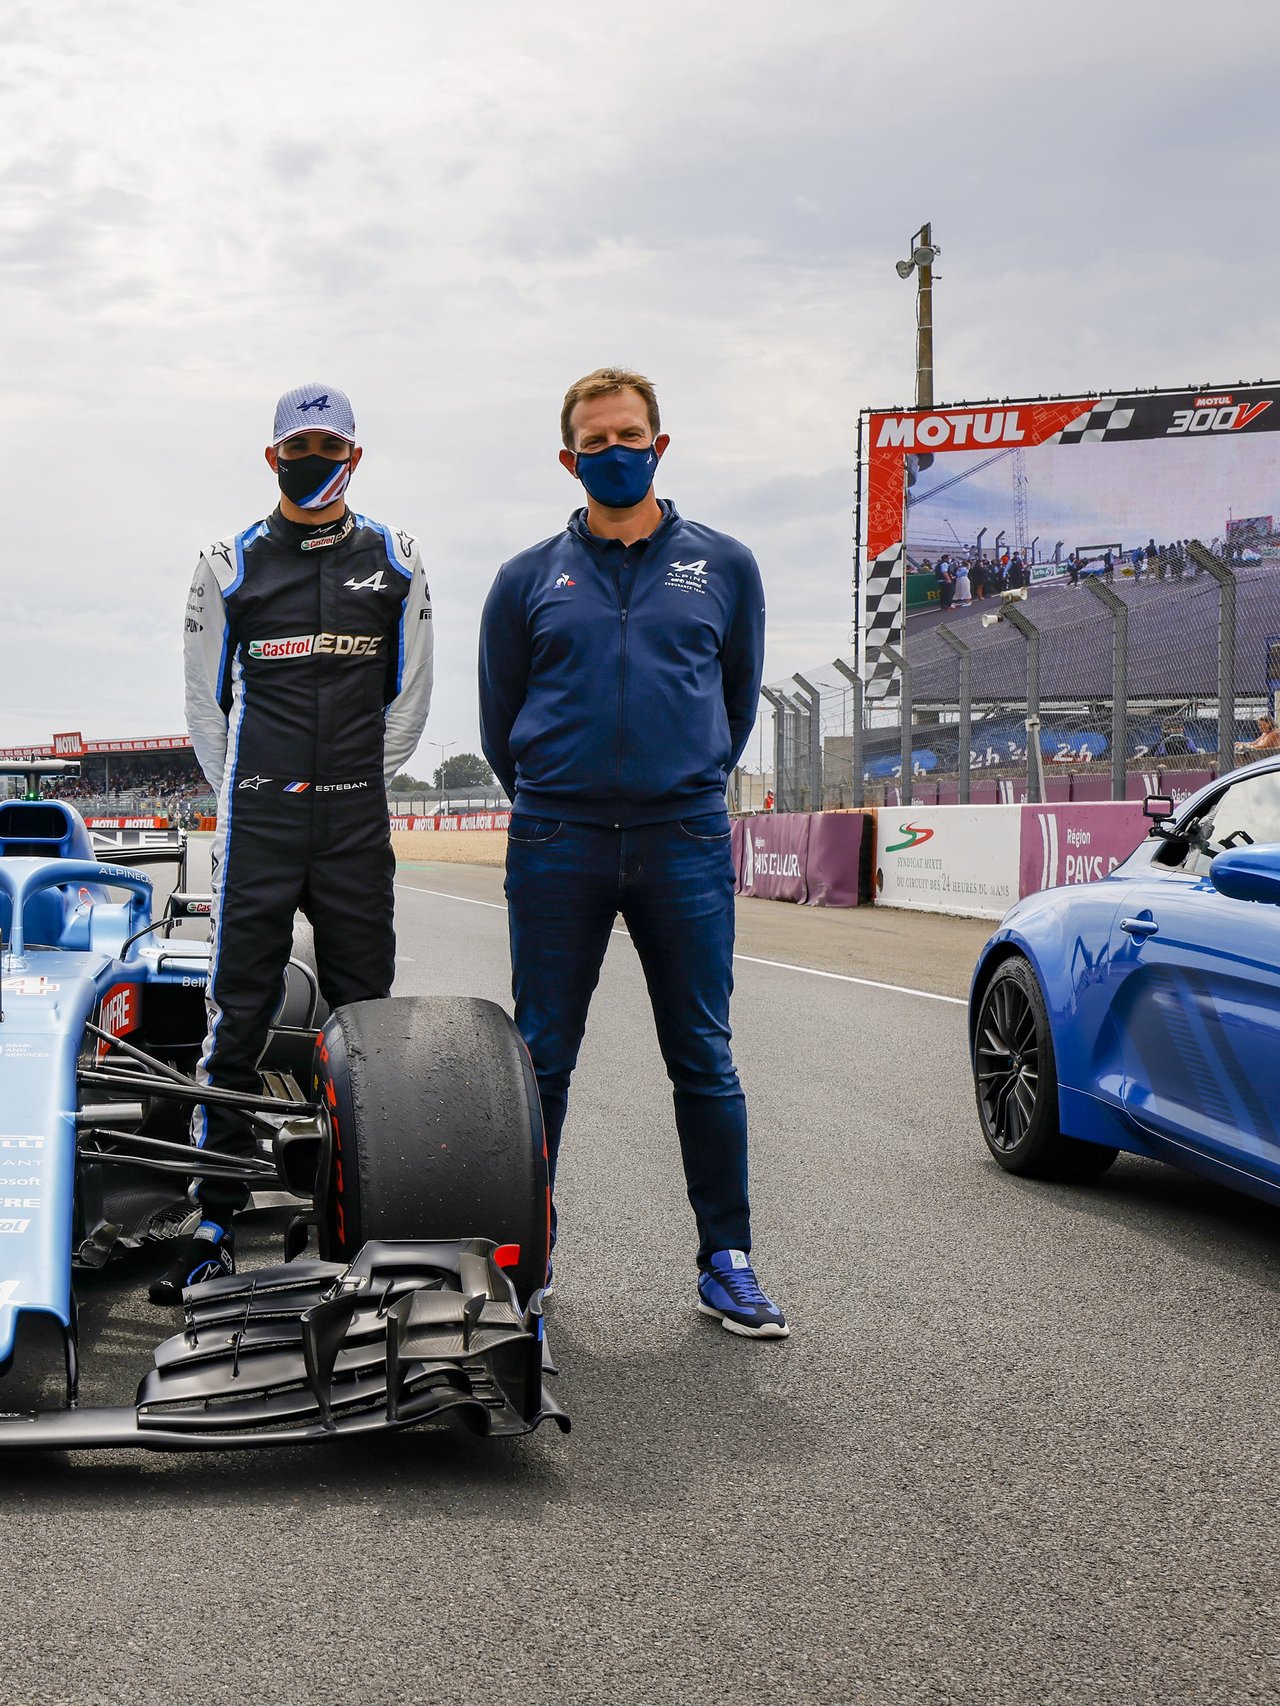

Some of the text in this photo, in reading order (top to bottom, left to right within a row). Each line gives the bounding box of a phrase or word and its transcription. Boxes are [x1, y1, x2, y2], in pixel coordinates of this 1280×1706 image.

[1196, 396, 1231, 407] MOTUL
[1166, 401, 1273, 434] 300V
[876, 411, 1025, 448] MOTUL
[310, 537, 334, 548] Castrol
[666, 572, 708, 585] ALPINE
[262, 632, 383, 658] Castrol EDGE
[55, 735, 82, 754] MOTUL
[315, 781, 368, 792] ESTEBAN
[91, 819, 155, 828] MOTUL MOTUL
[390, 818, 409, 831] OTUL
[412, 818, 435, 831] MOTUL
[1067, 829, 1091, 848] Région
[897, 857, 942, 870] SYNDICAT MIXTE
[1066, 855, 1104, 885] PAYS
[896, 877, 904, 887] DU
[905, 877, 928, 889] CIRCUIT
[930, 879, 940, 890] DES
[941, 873, 951, 891] 24
[952, 881, 977, 894] HEURES
[182, 976, 205, 988] Bell
